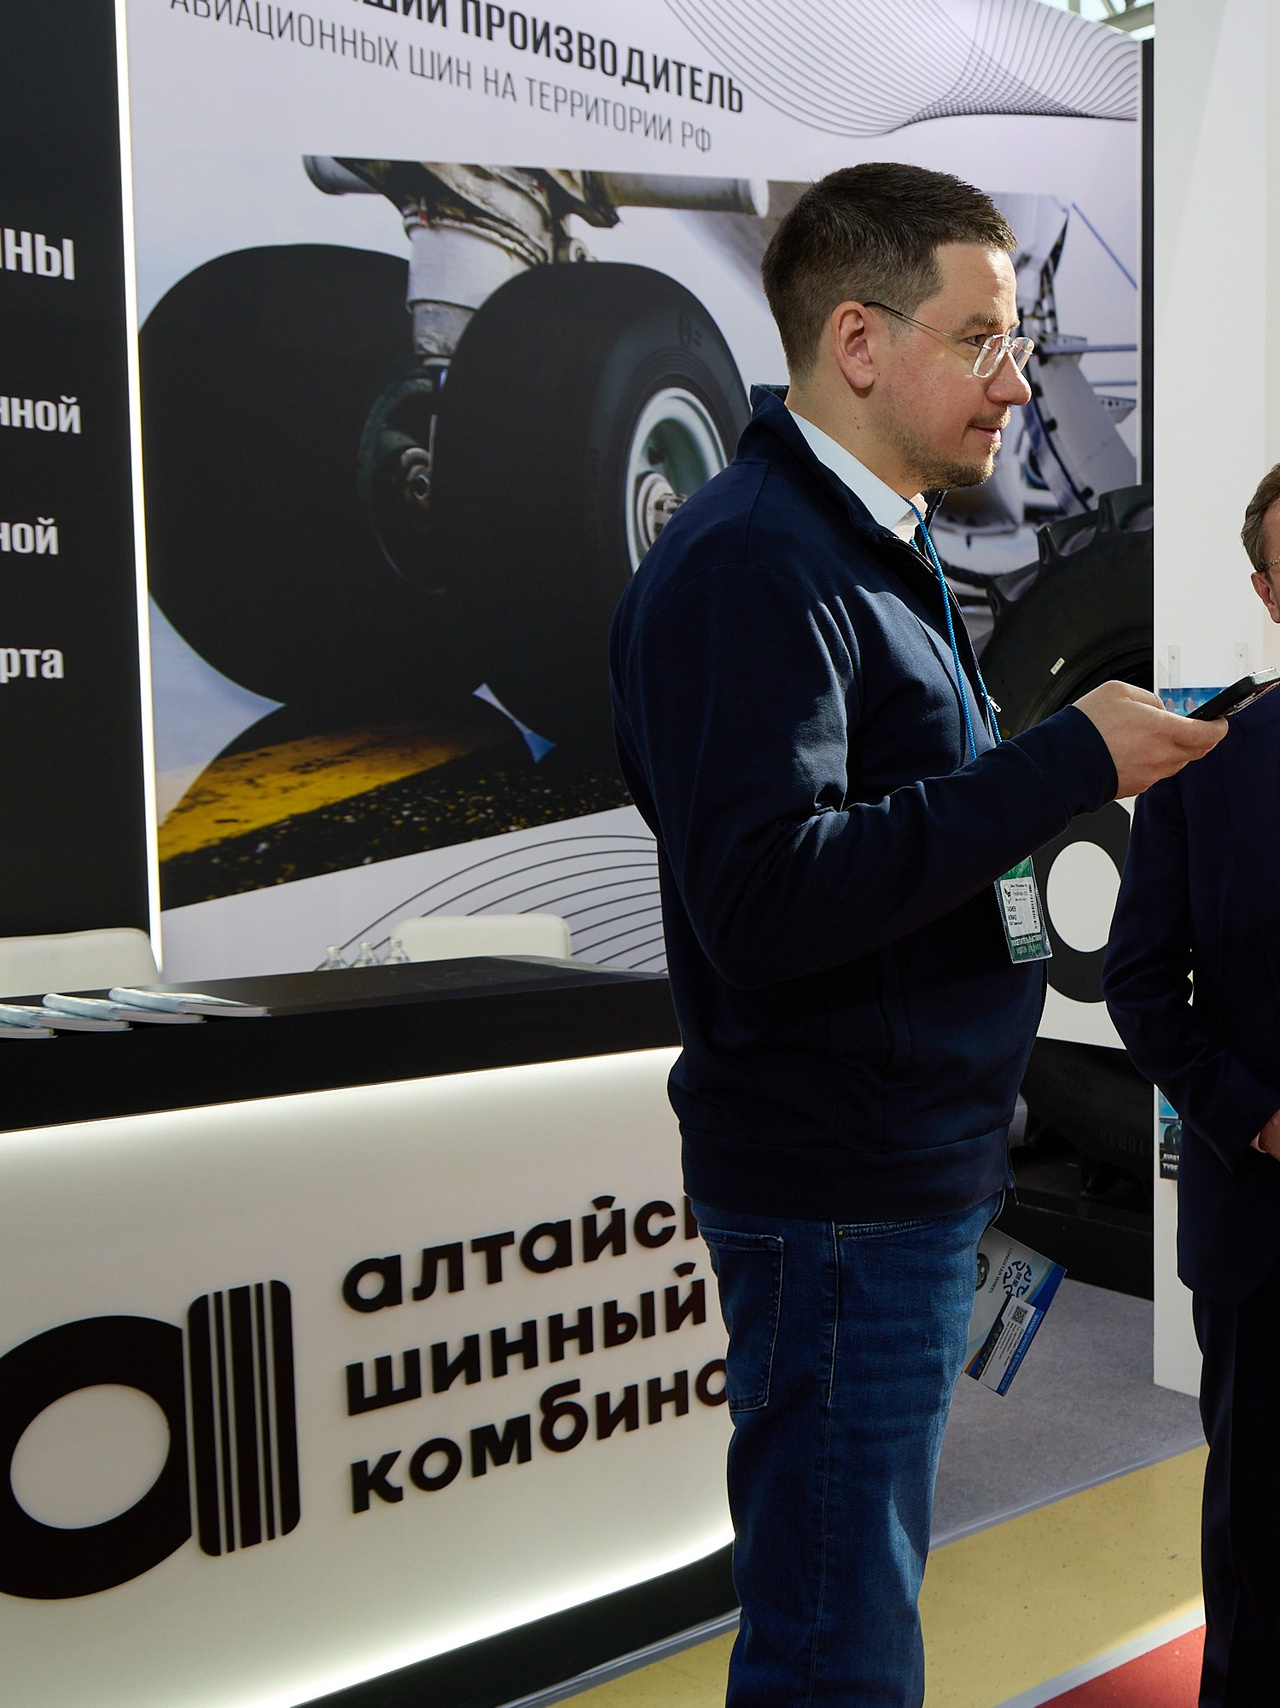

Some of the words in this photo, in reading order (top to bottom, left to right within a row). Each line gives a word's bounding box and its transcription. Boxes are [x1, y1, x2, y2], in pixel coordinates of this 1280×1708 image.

[409, 44, 472, 90] ШИН
[484, 65, 517, 102] НА
[525, 76, 673, 144] ТЕРРИТОРИИ
[681, 120, 712, 152] РФ
[461, 0, 743, 114] ПРОИЗВОДИТЕЛЬ
[0, 227, 75, 281] НЫ
[345, 1262, 706, 1416] шинный
